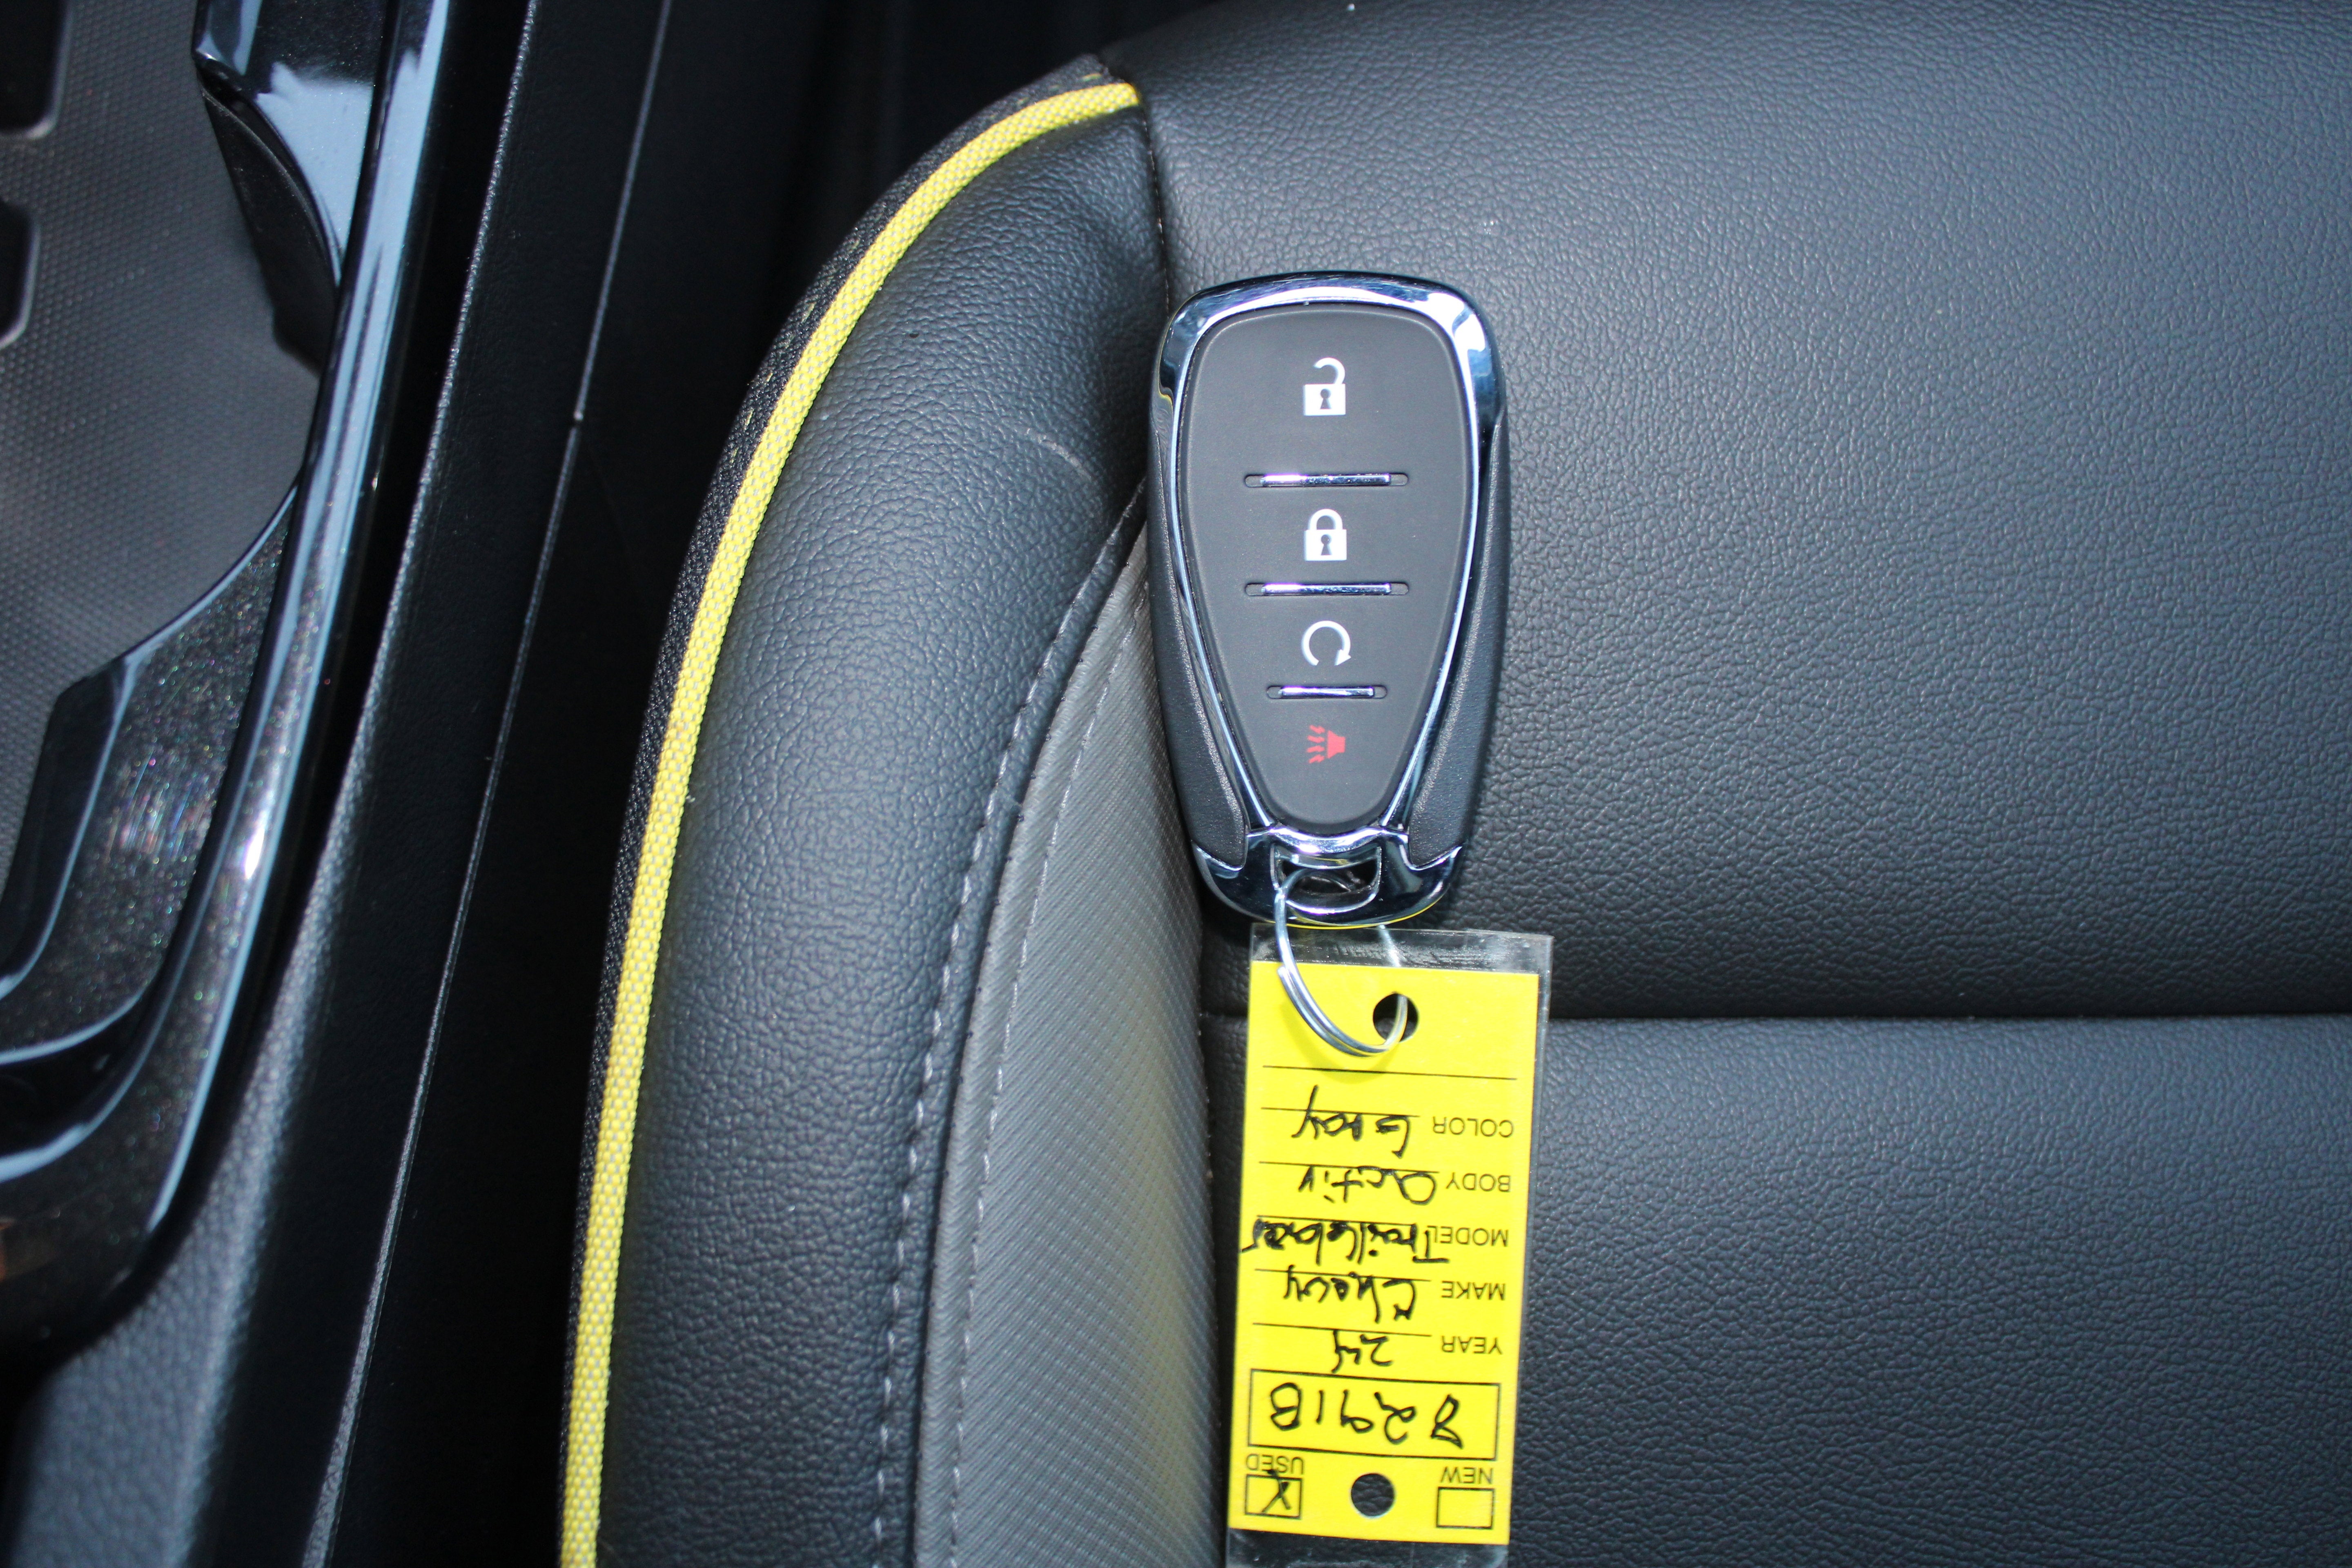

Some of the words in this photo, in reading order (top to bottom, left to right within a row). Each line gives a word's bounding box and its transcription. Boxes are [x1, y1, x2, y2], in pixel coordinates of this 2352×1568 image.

[1432, 1116, 1514, 1138] COLOR
[1446, 1172, 1511, 1193] BODY
[1427, 1226, 1509, 1247] MODEL
[1283, 1265, 1417, 1324] Chevy
[1441, 1281, 1506, 1301] MAKE
[1331, 1330, 1393, 1374] 24
[1441, 1335, 1503, 1355] YEAR
[1246, 1454, 1304, 1475] USED
[1440, 1467, 1494, 1484] NEW
